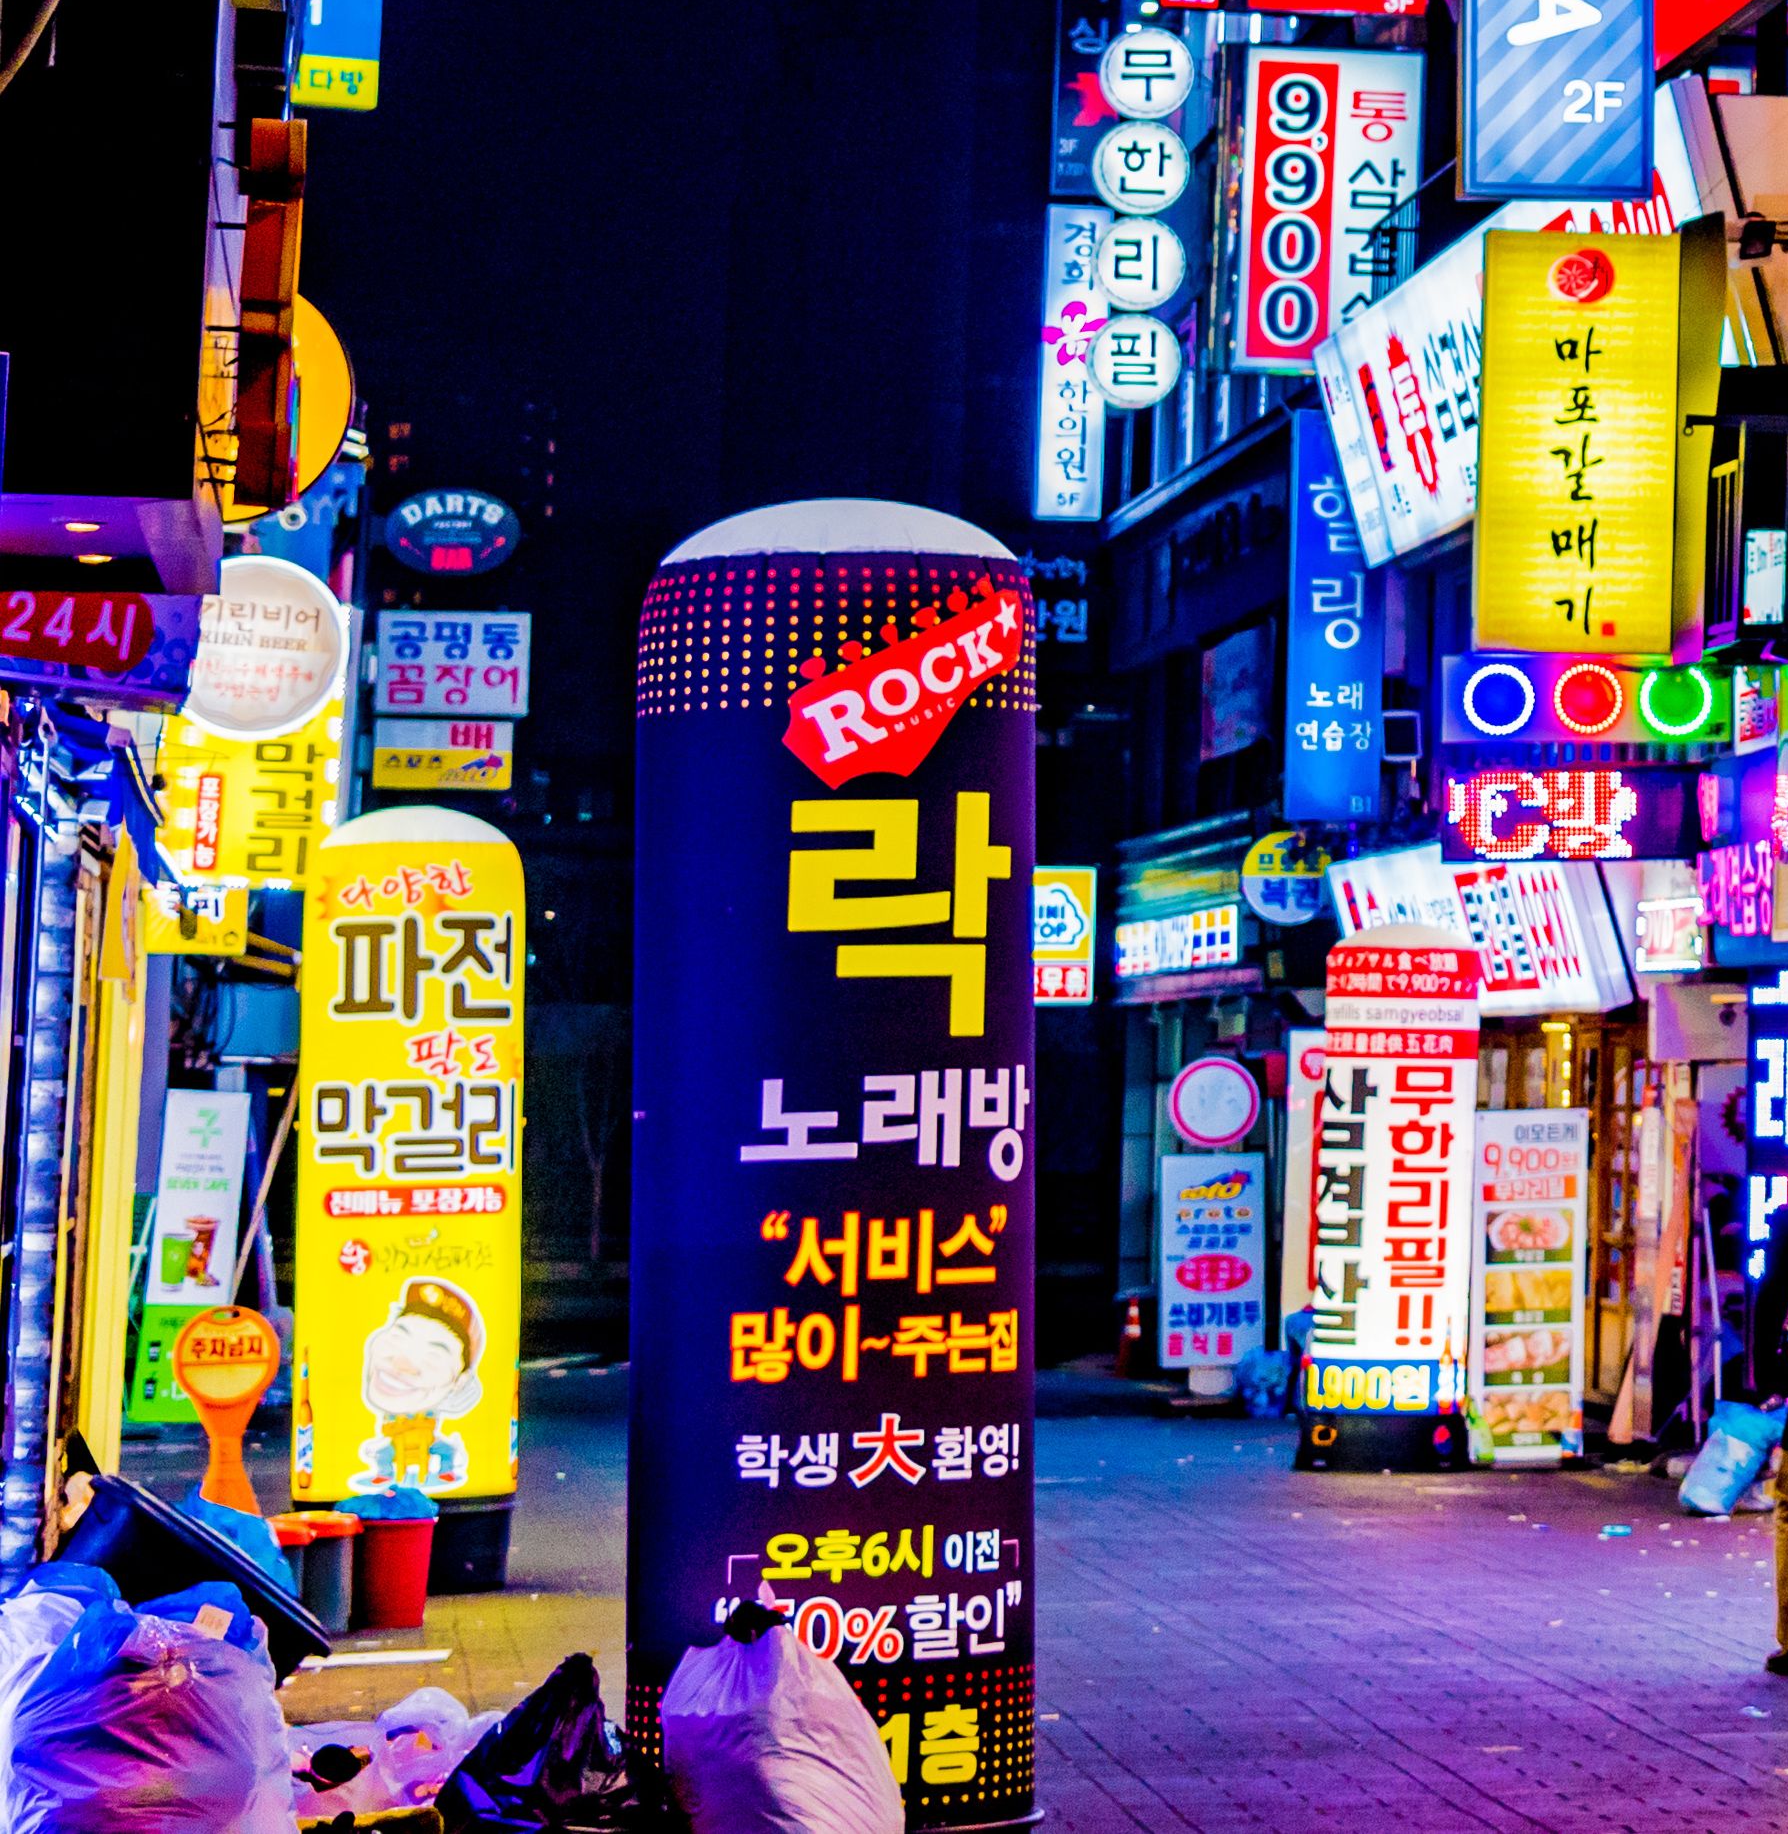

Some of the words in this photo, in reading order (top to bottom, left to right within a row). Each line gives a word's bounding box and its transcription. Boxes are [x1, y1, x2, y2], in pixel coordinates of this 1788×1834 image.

[1561, 80, 1626, 125] 2F
[1108, 48, 1176, 388] 무한리필
[1549, 325, 1604, 639] 마포갈매기
[400, 494, 504, 525] DARTS
[2, 591, 139, 660] 24시
[200, 602, 322, 634] 기린비어
[389, 620, 521, 660] 공평동
[387, 663, 520, 707] 꼼장어
[801, 620, 1005, 765] ROCK
[1306, 681, 1365, 711] 노래
[893, 696, 958, 735] MUSIC
[1294, 719, 1375, 752] 연습장
[340, 861, 474, 909] 다양한
[786, 790, 1012, 1037] 락
[330, 913, 514, 1023] 파전
[405, 1032, 499, 1078] 팔도
[312, 1080, 518, 1174] 막걸리
[738, 1064, 1030, 1182] 노래방
[410, 1186, 505, 1215] 포장가능
[729, 1304, 1019, 1384] 많이~주는집
[735, 1432, 840, 1488] 학생
[847, 1412, 927, 1489] 大
[931, 1422, 1020, 1481] 환영!
[761, 1524, 935, 1584] 오후6시
[943, 1527, 1002, 1573] 이전
